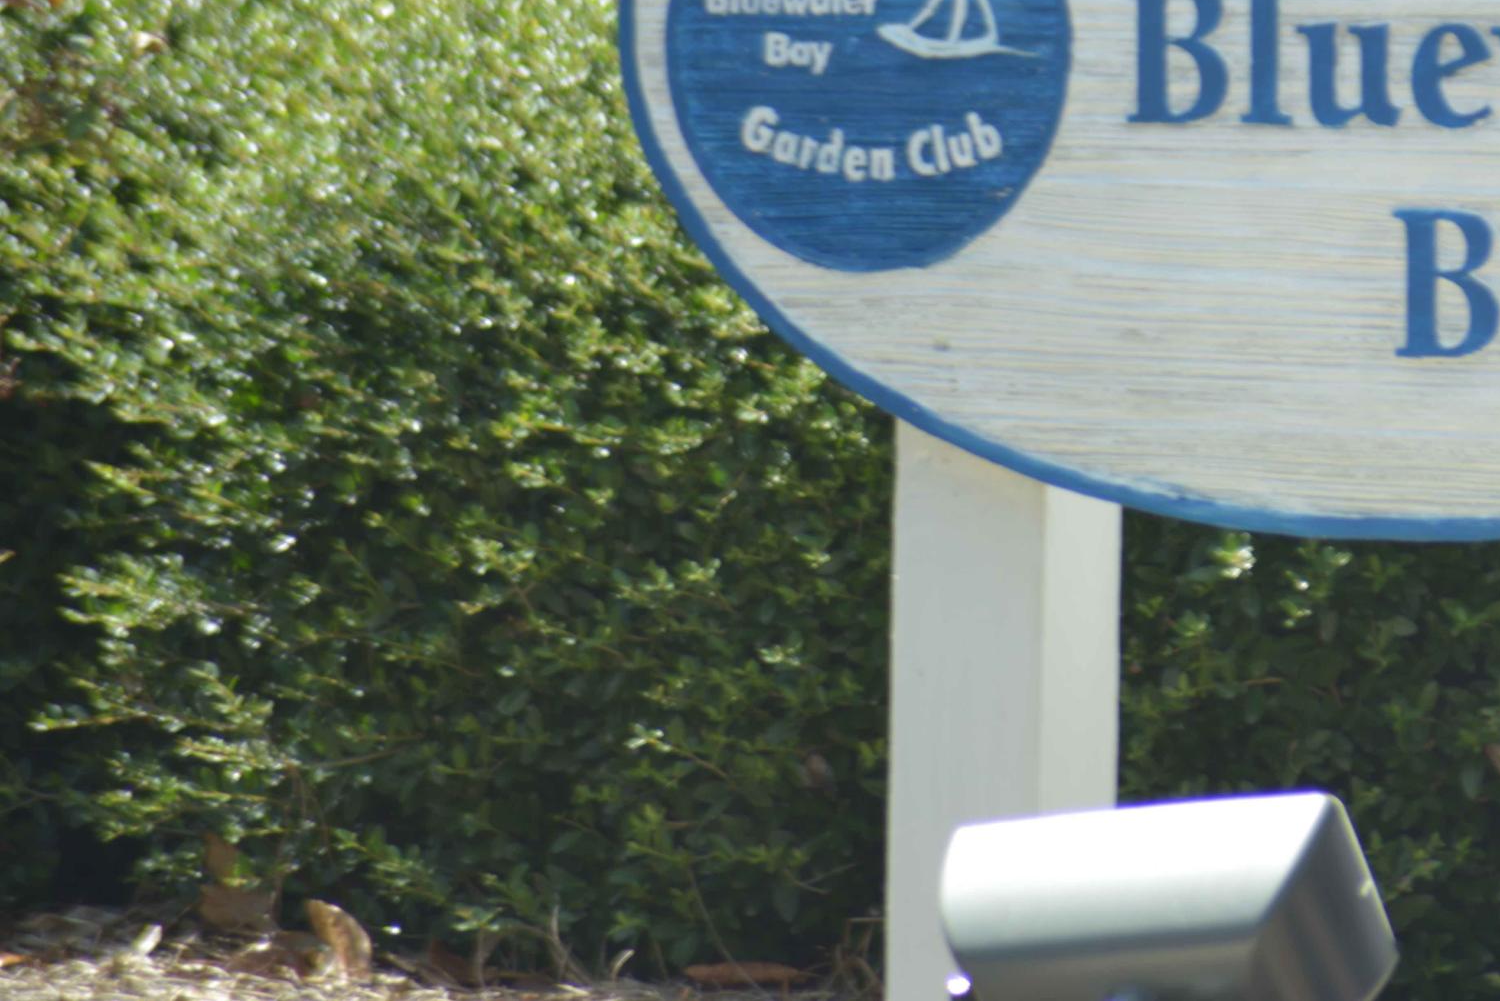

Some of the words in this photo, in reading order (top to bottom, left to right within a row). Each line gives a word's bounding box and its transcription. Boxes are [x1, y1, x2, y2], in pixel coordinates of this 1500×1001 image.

[763, 31, 833, 75] Bay
[741, 105, 897, 182] Garden
[906, 111, 1003, 177] Club
